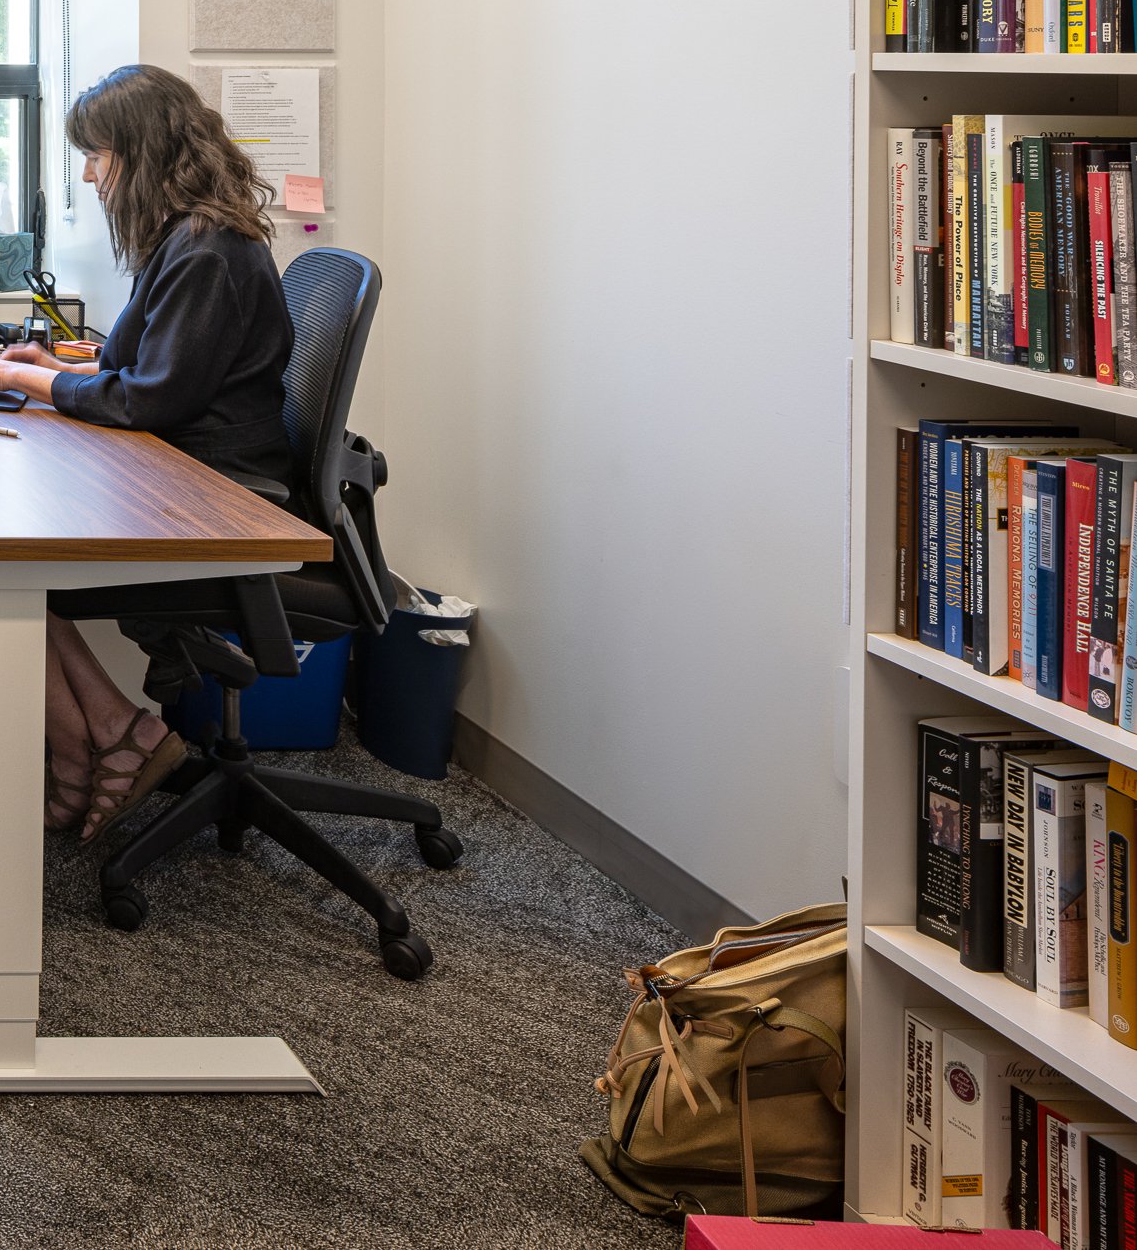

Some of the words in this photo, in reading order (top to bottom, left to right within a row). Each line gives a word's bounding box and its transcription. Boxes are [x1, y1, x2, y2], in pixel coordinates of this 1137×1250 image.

[917, 141, 928, 175] Beyond
[1028, 145, 1039, 181] IGARASHI
[895, 162, 909, 201] Southern
[917, 177, 928, 192] the
[1054, 166, 1063, 224] AMERICAN
[1116, 175, 1125, 195] THE
[894, 204, 904, 239] Heritage
[917, 194, 928, 241] Battlefield
[954, 195, 964, 216] The
[954, 220, 964, 254] Power
[1117, 199, 1126, 258] SHOEMAKER
[896, 241, 902, 252] on
[954, 257, 964, 268] of
[1056, 228, 1065, 278] MEMORY
[1094, 240, 1105, 280] SILENCING
[894, 254, 904, 287] Display
[954, 271, 964, 302] Place
[1120, 261, 1128, 283] AND
[1096, 282, 1106, 298] THE
[1097, 299, 1107, 319] PAST
[1122, 330, 1131, 362] PARTY
[1071, 481, 1091, 491] Mires
[1107, 470, 1118, 494] THE
[945, 489, 962, 559] HIROSHIMA
[964, 509, 969, 517] OF
[1028, 507, 1038, 525] THE
[1107, 499, 1118, 532] MYTH
[1012, 505, 1022, 562] RAMONA
[1028, 529, 1038, 571] SELLING
[1106, 538, 1115, 555] OF
[945, 563, 962, 608] TRACES
[1028, 574, 1038, 589] OF
[1077, 522, 1094, 617] INDEPENDENCE
[1104, 559, 1114, 598] SANTA
[1012, 568, 1022, 640] MEMORIES
[1026, 592, 1038, 616] 9/11
[1103, 604, 1113, 620] FE
[1075, 620, 1092, 653] HALL
[1124, 676, 1134, 724] BOKOVOY
[938, 748, 958, 763] Call
[1006, 762, 1025, 801] NEW
[962, 803, 972, 853] LYNCHING
[1006, 800, 1025, 833] DAY
[1006, 832, 1025, 855] IN
[962, 856, 972, 870] TO
[962, 870, 972, 910] BELONG
[1006, 853, 1025, 925] BABYLON
[1045, 867, 1057, 903] SOUL
[926, 917, 957, 934] HOUGHTON
[931, 924, 953, 936] MIFFLIN
[1045, 905, 1057, 926] BY
[1045, 926, 1057, 965] SOUL
[906, 1020, 916, 1070] FREEDOM
[915, 1038, 924, 1052] IN
[924, 1040, 933, 1060] THE
[915, 1052, 924, 1096] SLAVERY
[924, 1060, 933, 1093] BLACK
[906, 1073, 916, 1126] 1750-1925
[915, 1095, 924, 1118] AND
[924, 1093, 933, 1132] FAMILY
[910, 1143, 918, 1190] GUTMAN
[918, 1143, 927, 1194] HERBERT
[918, 1192, 927, 1203] G.
